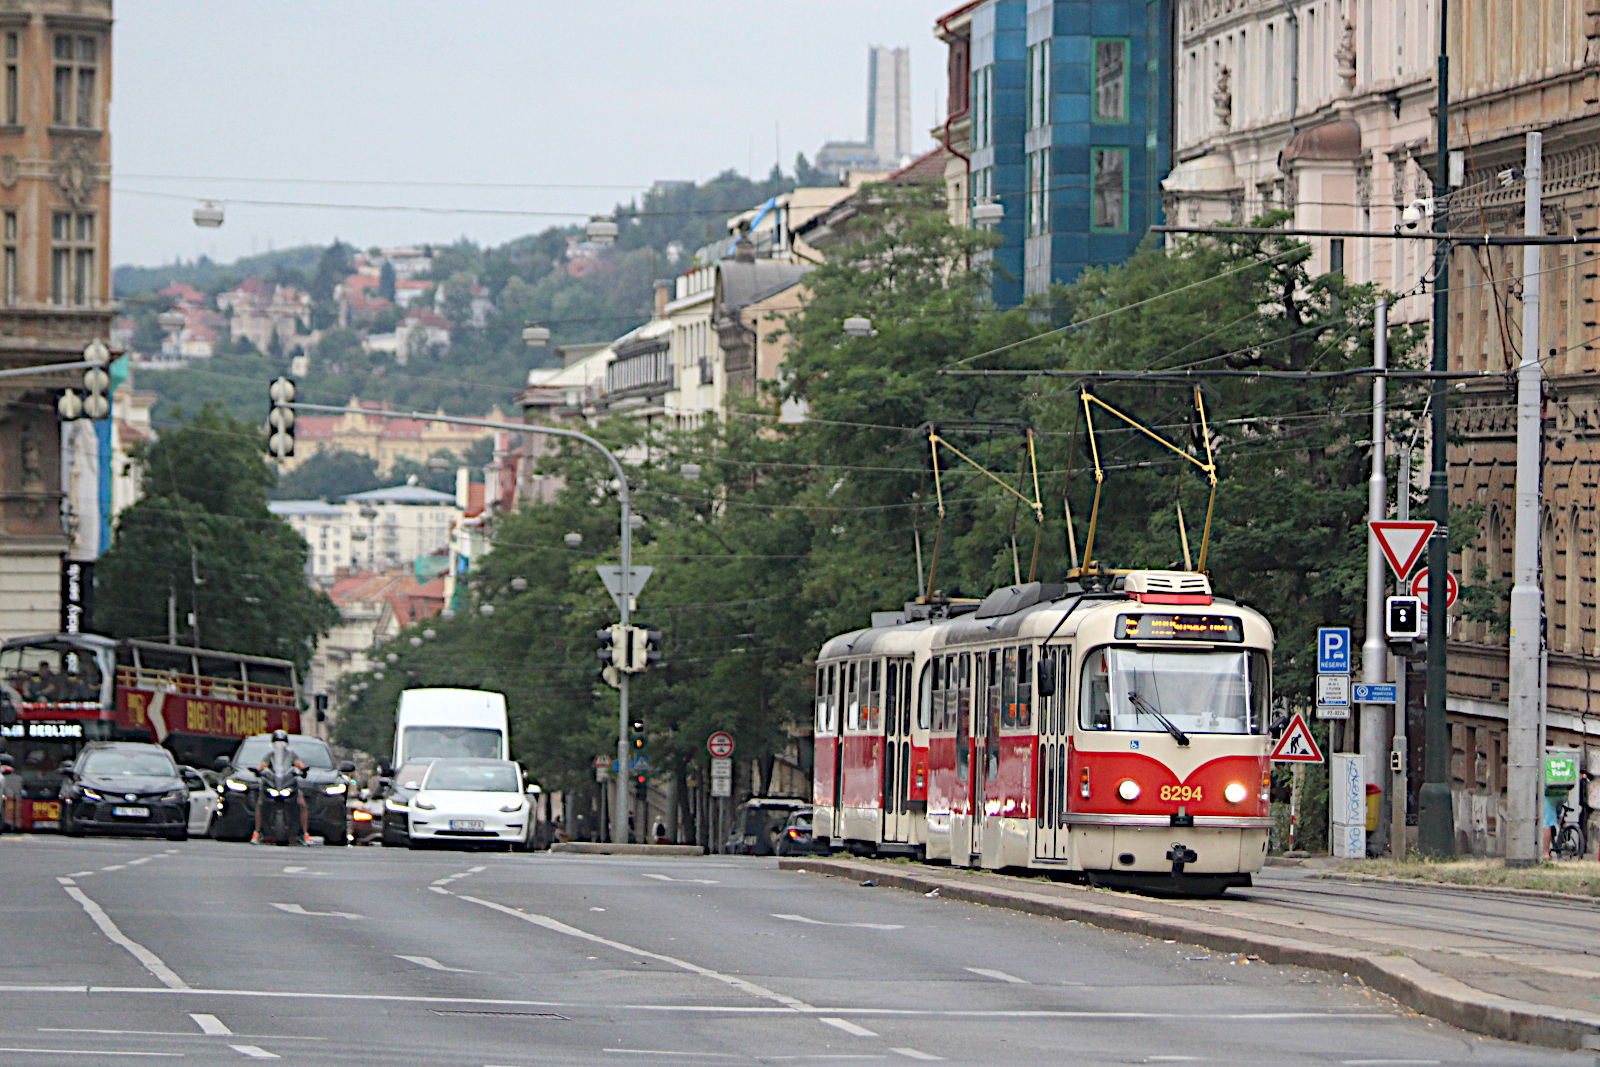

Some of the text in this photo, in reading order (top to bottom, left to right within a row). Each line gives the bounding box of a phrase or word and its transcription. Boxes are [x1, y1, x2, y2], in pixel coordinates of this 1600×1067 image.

[1325, 633, 1343, 660] P
[224, 704, 268, 736] PRAGUE
[1551, 761, 1566, 769] Bolt
[1552, 769, 1571, 777] Food
[1160, 785, 1203, 801] 8294
